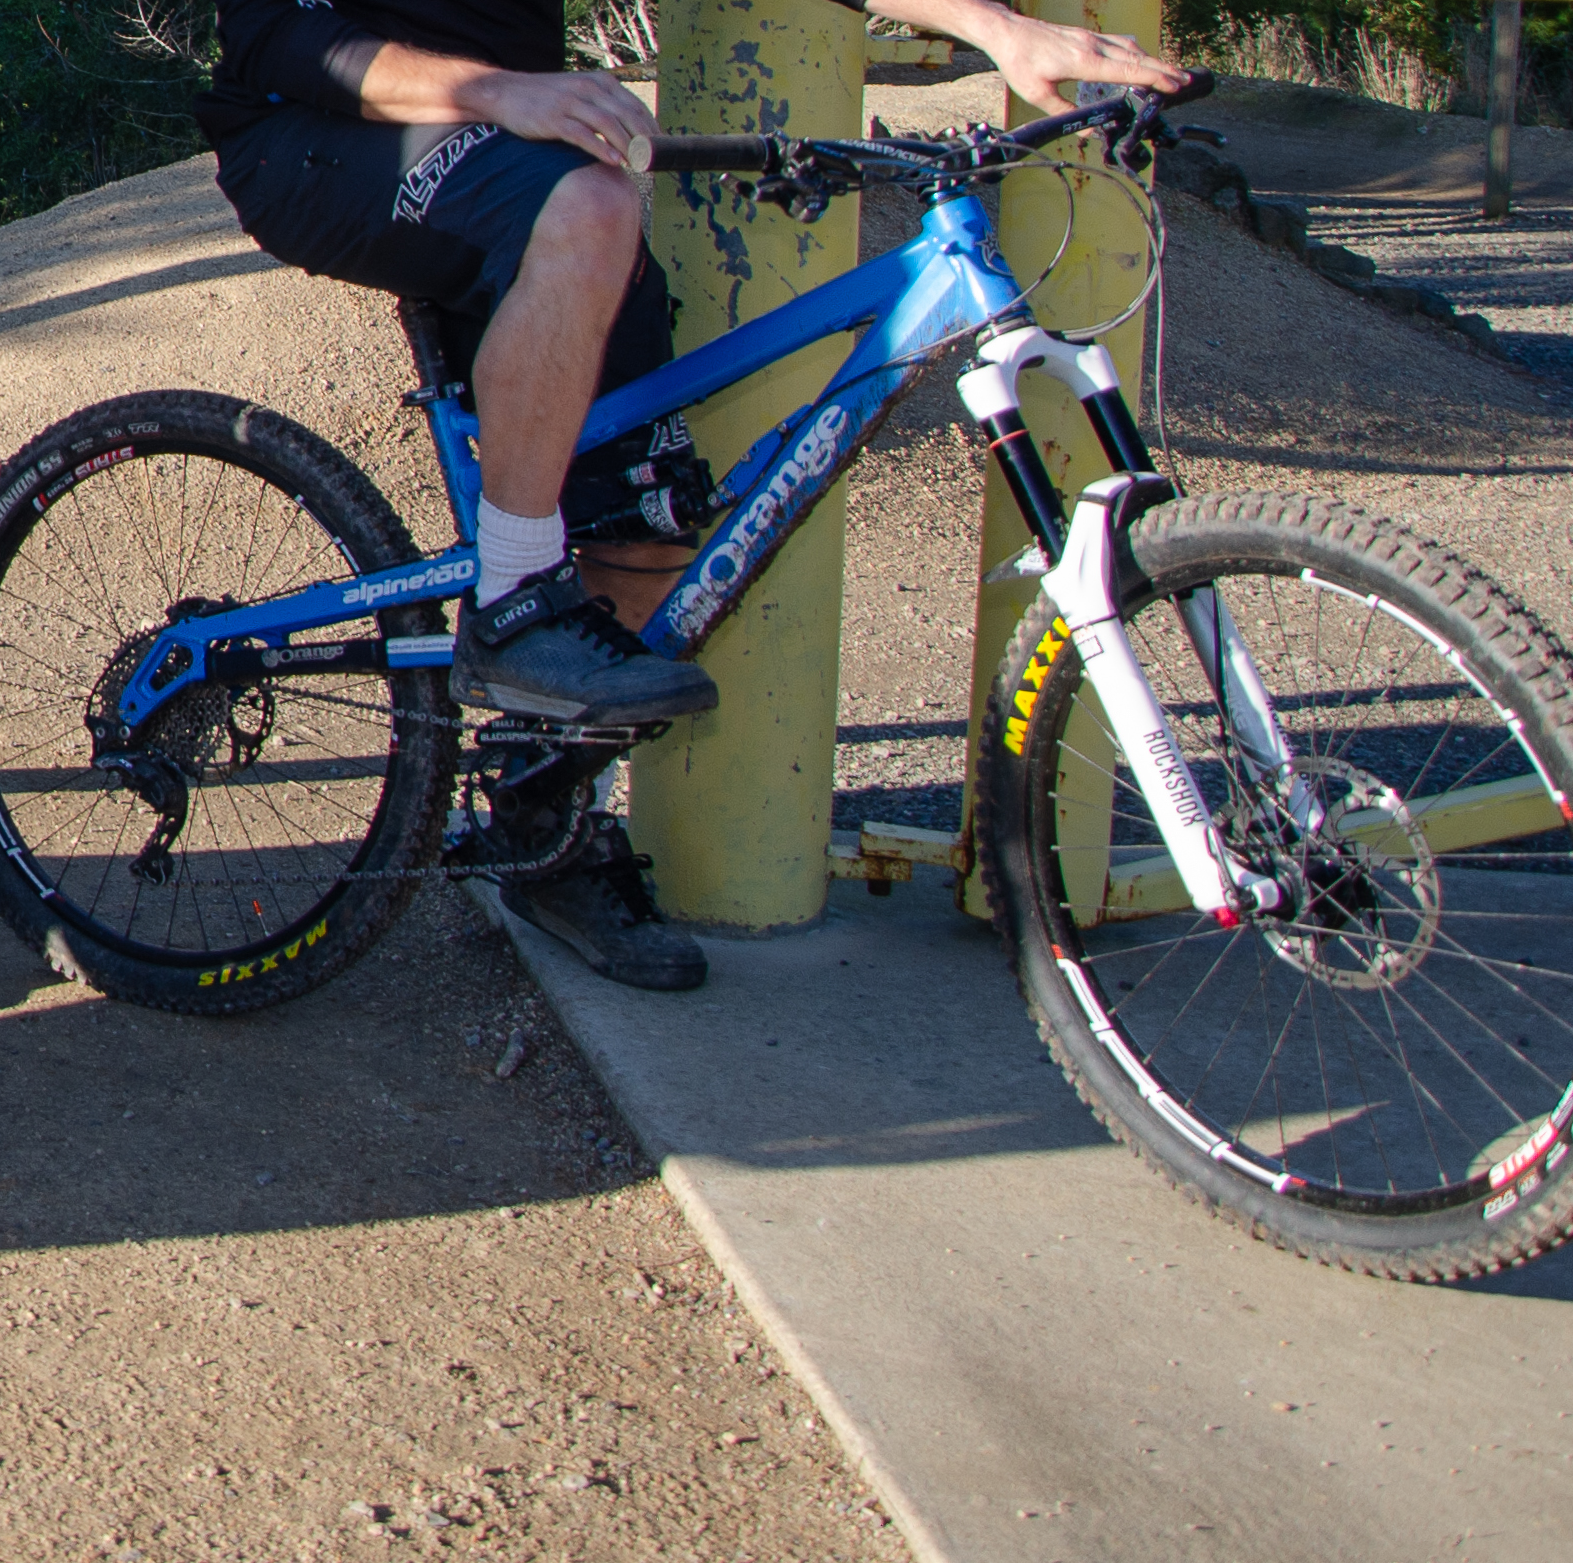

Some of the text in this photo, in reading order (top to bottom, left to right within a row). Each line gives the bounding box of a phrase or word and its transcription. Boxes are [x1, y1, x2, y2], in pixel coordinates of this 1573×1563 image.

[700, 405, 850, 593] Orange
[279, 645, 344, 663] Orange
[493, 599, 537, 629] GIRO
[1004, 616, 1071, 756] MAXXI
[1143, 729, 1205, 827] ROCKSHOX
[198, 918, 326, 986] MAXXIS
[1057, 957, 1291, 1194] ARCH
